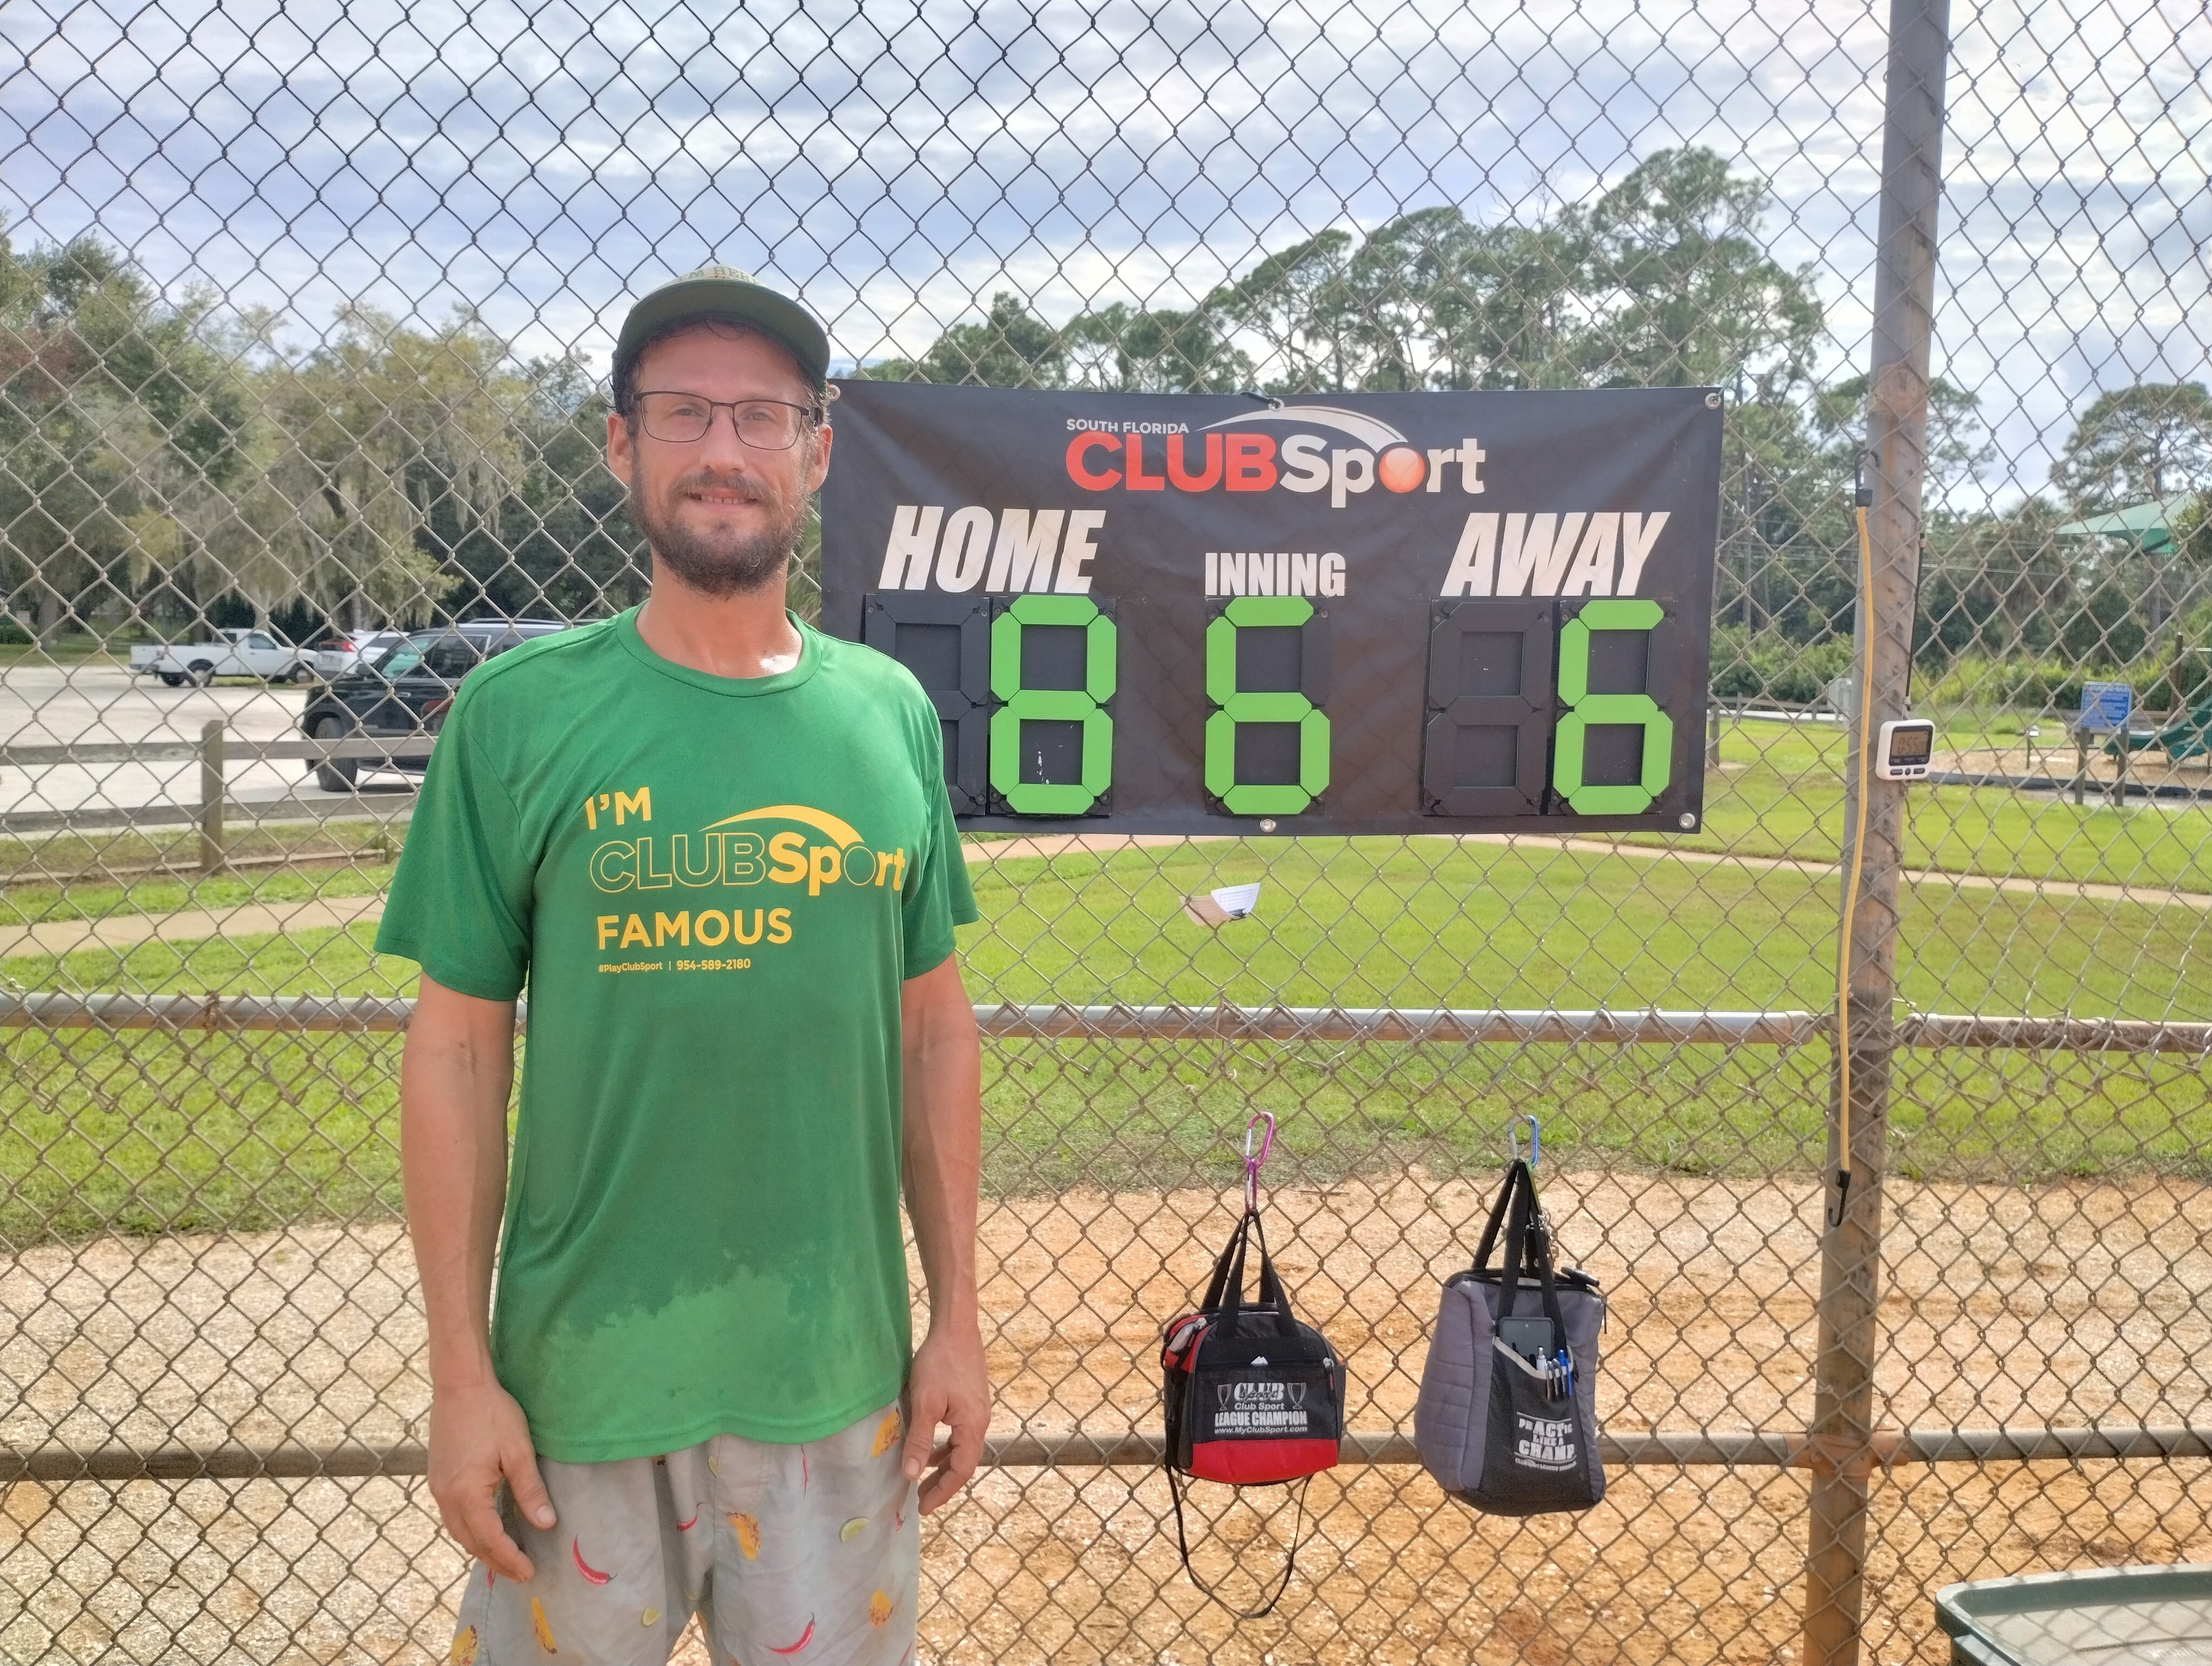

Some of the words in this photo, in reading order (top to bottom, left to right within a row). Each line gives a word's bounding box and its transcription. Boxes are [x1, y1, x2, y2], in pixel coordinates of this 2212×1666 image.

[1066, 418, 1118, 432] SOUTH
[1123, 422, 1189, 434] FLORIDA
[878, 505, 1107, 594] HOME
[1440, 512, 1671, 597] AWAY
[1205, 552, 1346, 597] INNING
[990, 594, 1117, 815] 8
[1205, 597, 1330, 815] 6
[1553, 600, 1673, 815] 6
[586, 786, 652, 830] I'M
[597, 908, 793, 950] FAMOUS
[598, 962, 664, 973] #PlayClubSport
[677, 958, 751, 971] 954-589-2180
[1215, 1411, 1251, 1427] LEAGUE
[1251, 1411, 1308, 1426] CHAMPION
[1234, 1402, 1256, 1410] Club
[1258, 1402, 1285, 1411] Sport
[1214, 1426, 1308, 1434] www.MyClubSport.com
[1519, 1439, 1575, 1461] CHAMP
